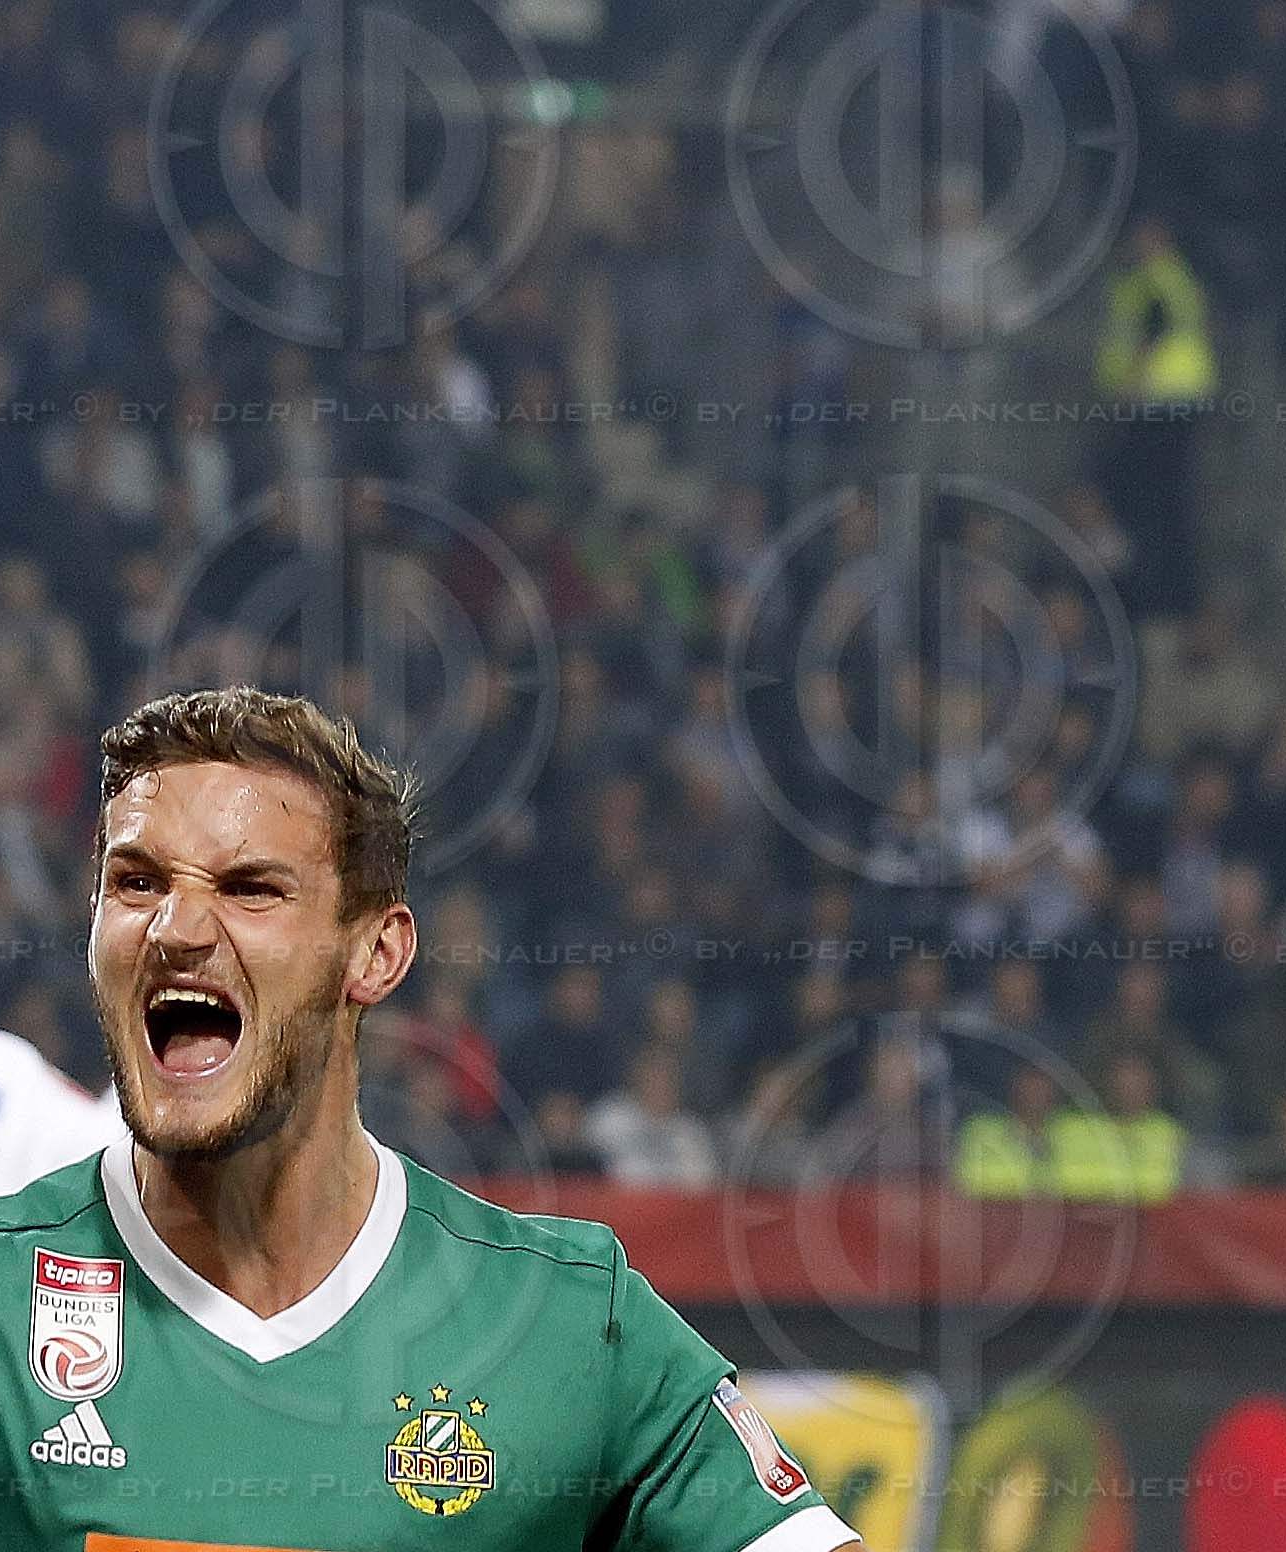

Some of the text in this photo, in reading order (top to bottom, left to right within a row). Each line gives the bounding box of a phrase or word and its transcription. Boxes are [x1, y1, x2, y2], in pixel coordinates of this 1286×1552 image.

[44, 1259, 114, 1287] tipico
[40, 1293, 115, 1314] BUNDES
[54, 1312, 97, 1327] LIGA
[29, 1439, 127, 1469] adidas
[395, 1450, 488, 1484] RAPID
